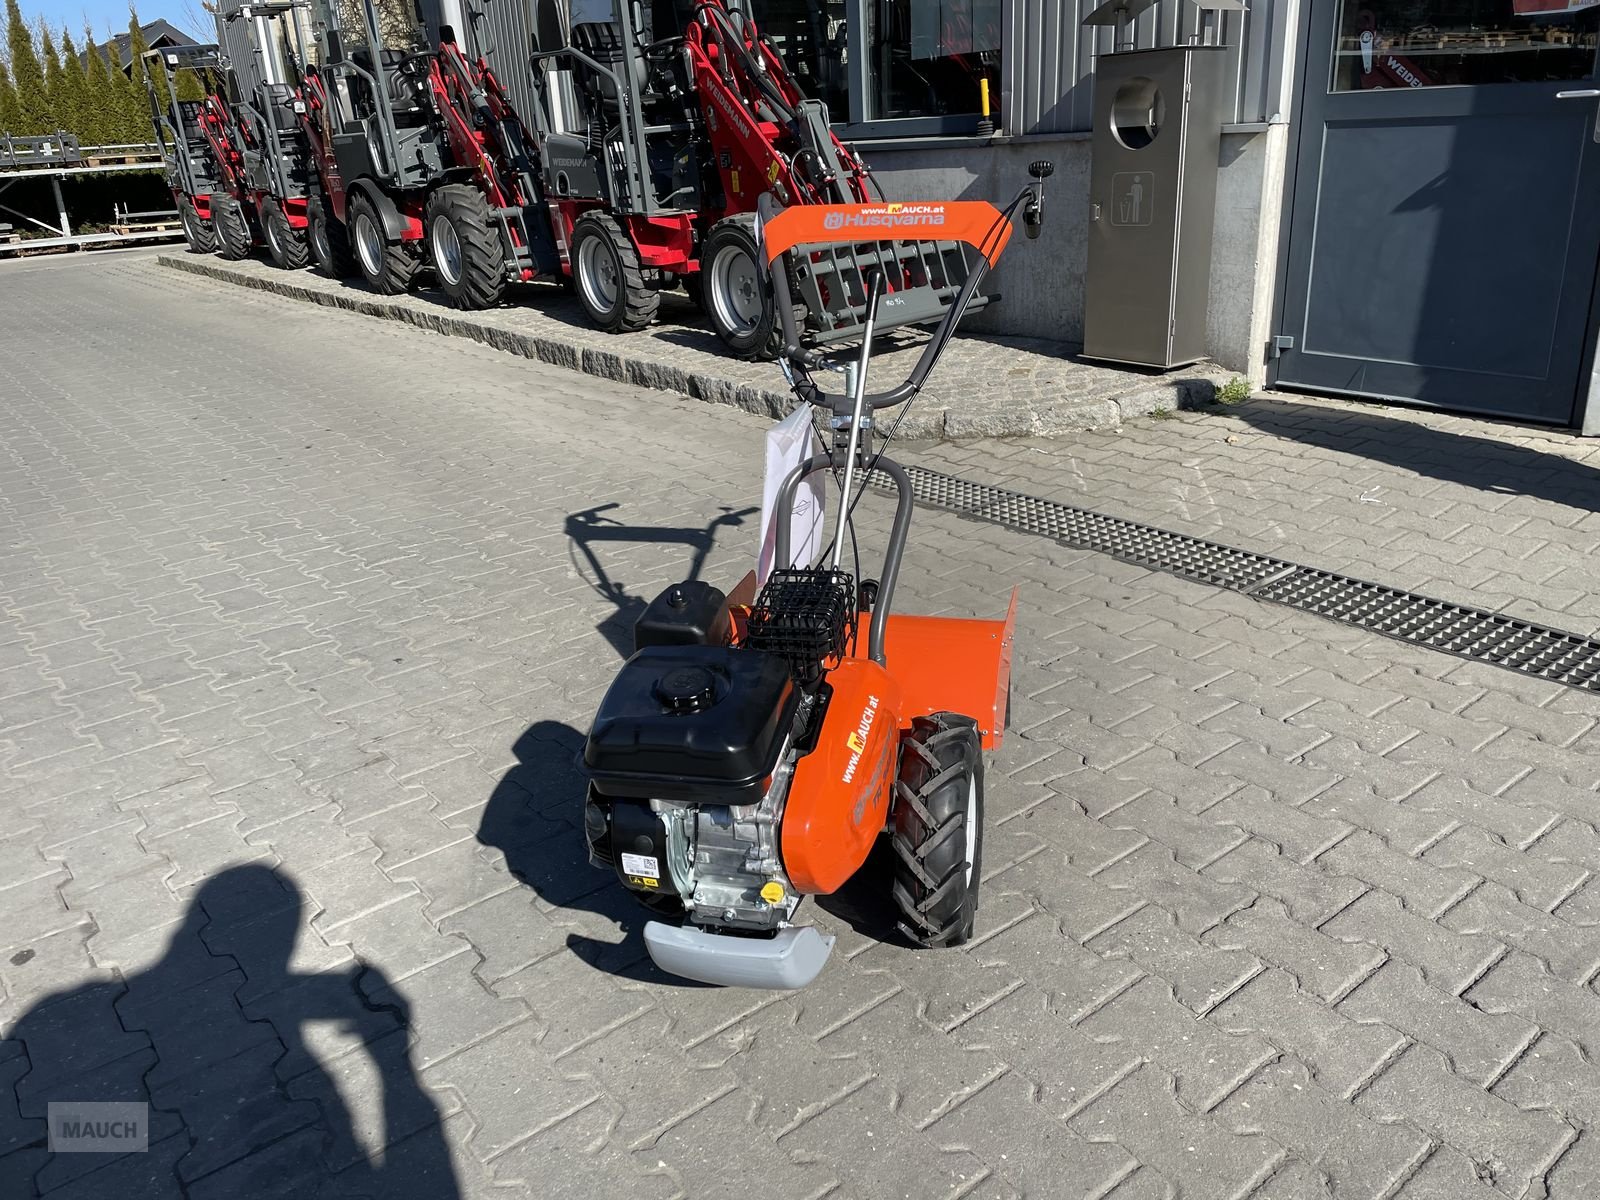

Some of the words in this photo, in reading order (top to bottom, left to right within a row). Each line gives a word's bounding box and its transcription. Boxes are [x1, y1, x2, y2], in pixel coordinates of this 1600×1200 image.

[706, 77, 750, 139] WEIDEMANN
[861, 204, 945, 215] www.MAUCH.at
[845, 212, 945, 227] Husqvarna
